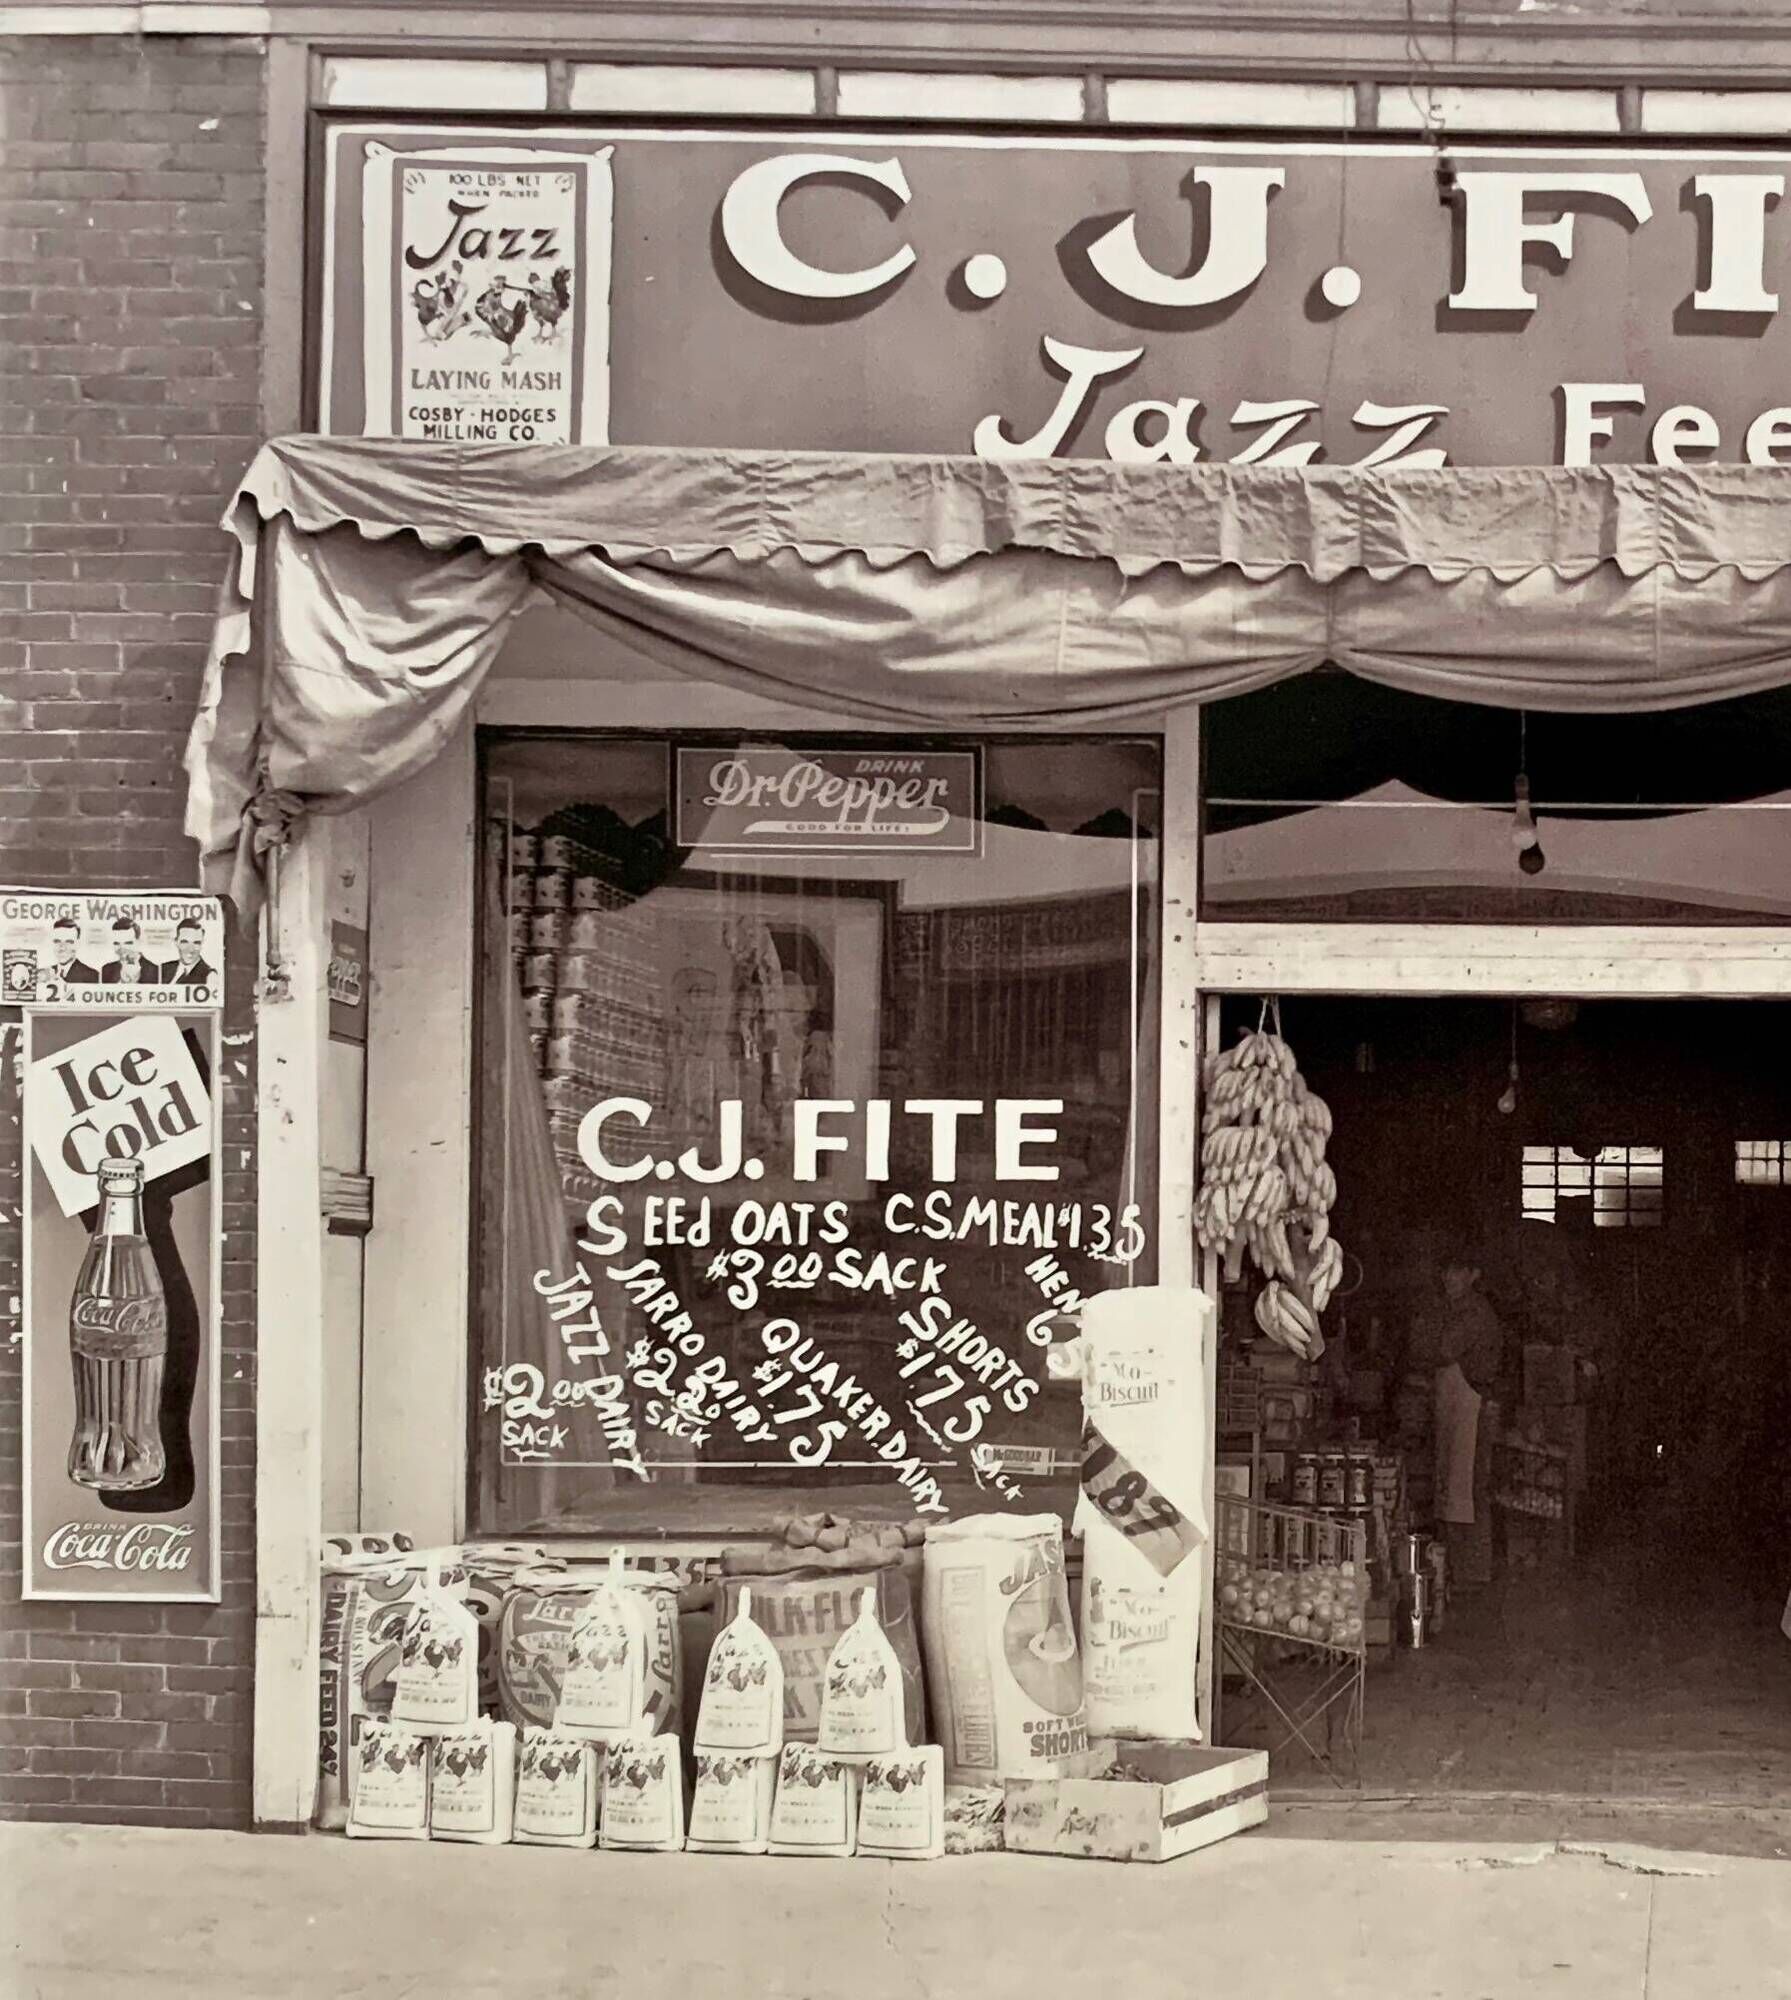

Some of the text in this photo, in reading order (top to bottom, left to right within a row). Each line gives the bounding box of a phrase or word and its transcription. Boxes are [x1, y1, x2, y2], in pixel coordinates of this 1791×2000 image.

[478, 174, 506, 187] LBS
[405, 198, 561, 269] Jazz
[411, 368, 562, 391] LAYING MASH
[974, 335, 1449, 468] Jazz
[408, 406, 465, 422] COSBY
[481, 408, 557, 423] HODGES
[423, 424, 497, 440] MILLING
[855, 759, 925, 774] DRINK
[785, 822, 828, 832] GOOD
[834, 823, 863, 833] FOR
[2, 899, 218, 921] GEORGE WASHINGTON
[82, 990, 142, 1003] OUNCES
[149, 991, 178, 1003] FOR
[51, 1047, 158, 1117] Ice
[61, 1080, 203, 1176] Cold
[794, 1099, 1064, 1182] FITE
[730, 1199, 849, 1246] OATS
[828, 1247, 947, 1295] SACK
[533, 1261, 651, 1484] JAZZ DAIRY
[898, 1296, 1040, 1413] SHORTS
[694, 1355, 779, 1443] DAIRY
[502, 1419, 570, 1449] SACK
[645, 1400, 712, 1449] SACK
[970, 1443, 1025, 1501] SACK
[82, 1523, 128, 1531] DRINK
[319, 1592, 347, 1664] DAIRY
[319, 1669, 339, 1728] FEED
[1023, 1718, 1063, 1734] SOFT
